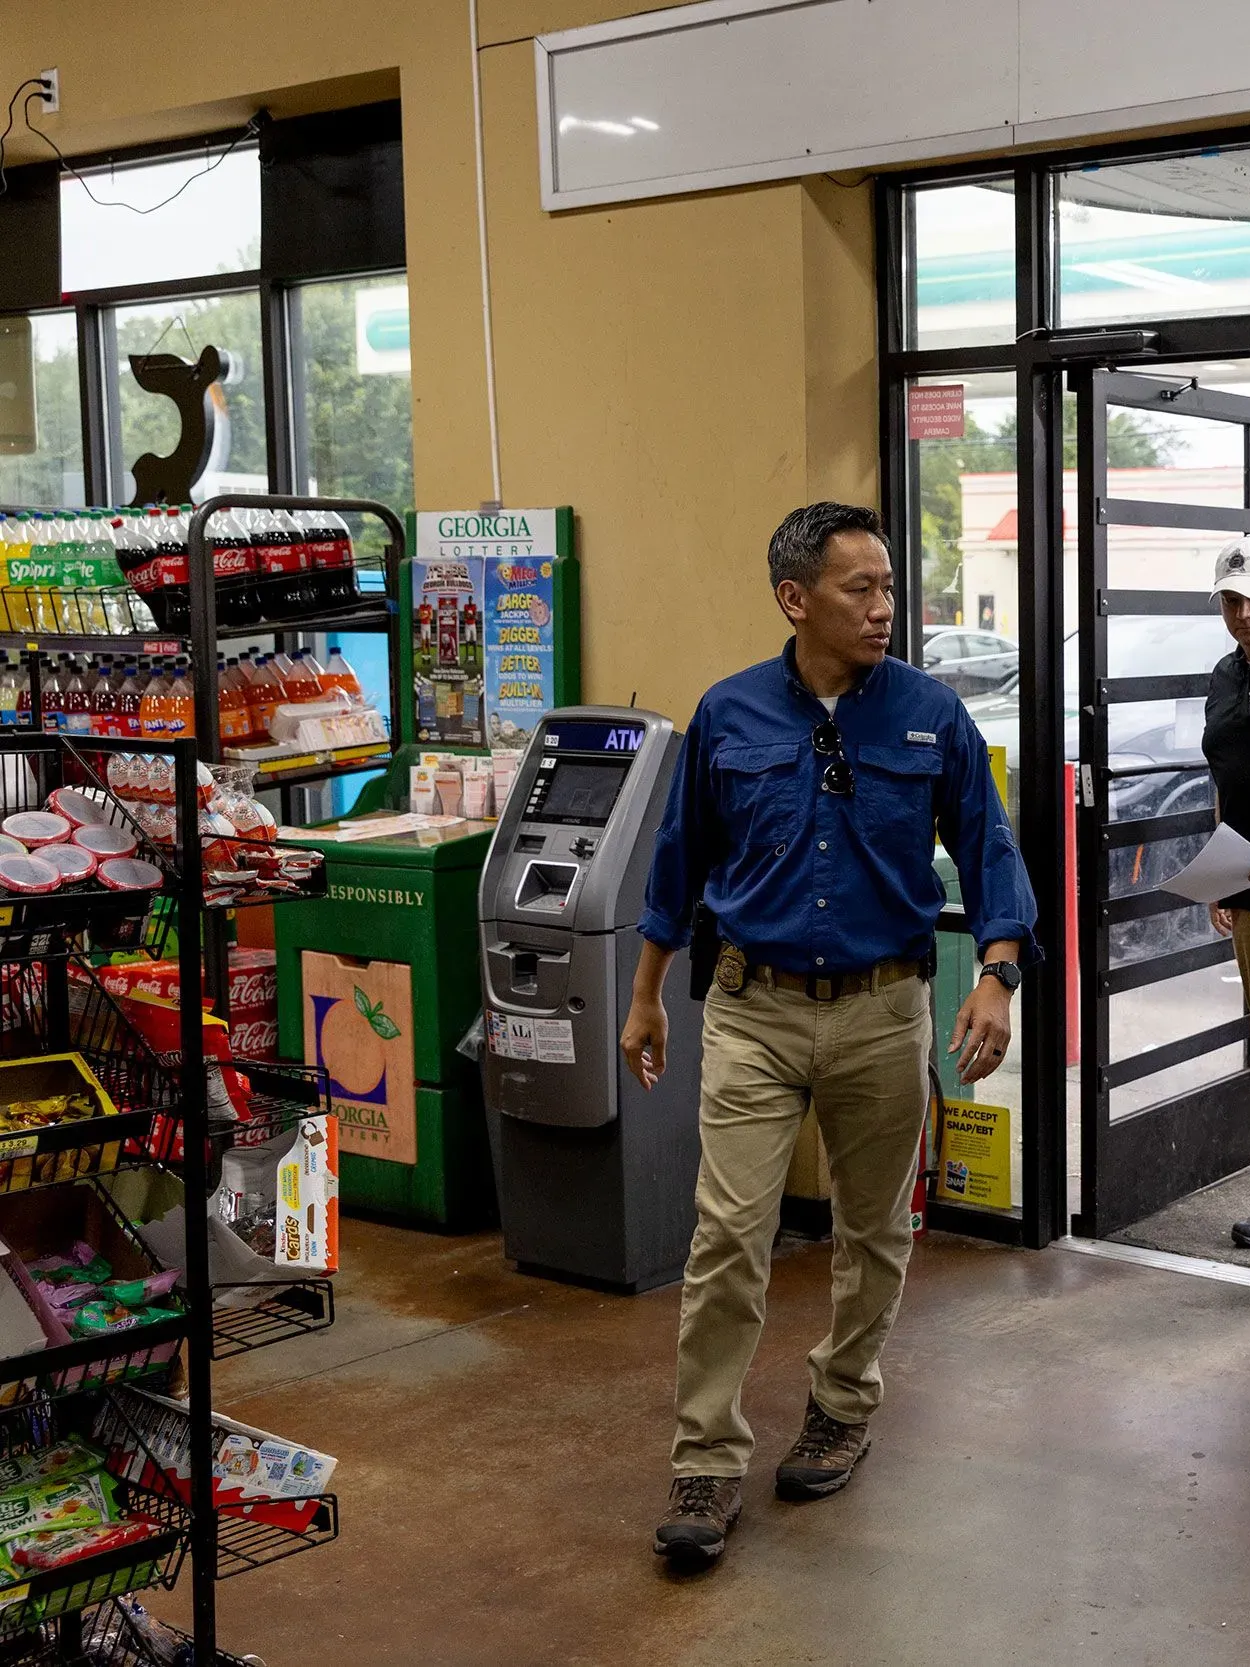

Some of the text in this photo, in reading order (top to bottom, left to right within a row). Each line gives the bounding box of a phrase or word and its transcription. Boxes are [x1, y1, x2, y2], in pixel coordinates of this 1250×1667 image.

[438, 515, 532, 538] GEORGIA
[440, 545, 532, 556] LOTTERY
[499, 626, 541, 645] BIGGER
[500, 654, 541, 673] BETTER
[499, 682, 544, 701] BUILT-IN
[604, 729, 646, 751] ATM
[323, 885, 424, 906] ESPONSIBLY
[943, 1106, 998, 1123] WE ACCEPT
[946, 1120, 995, 1136] SNAP/EBT
[946, 1175, 965, 1188] SNAP
[969, 1190, 988, 1199] Program
[285, 1215, 300, 1261] Cards
